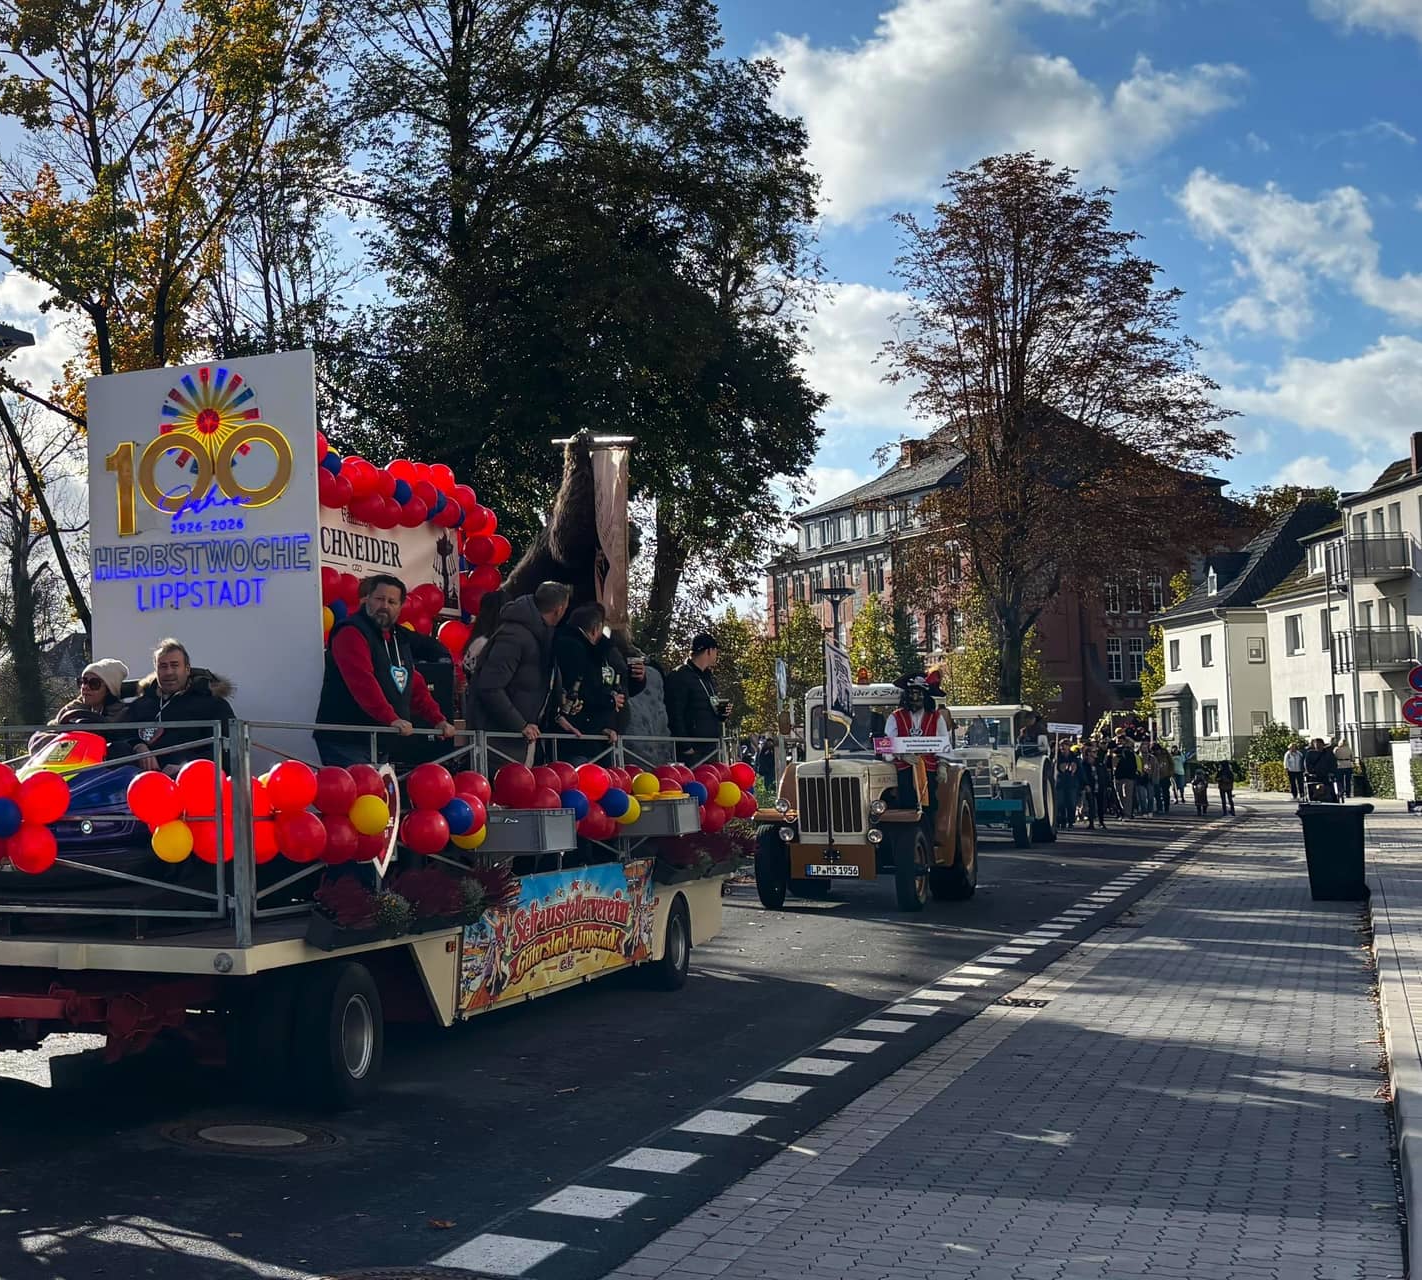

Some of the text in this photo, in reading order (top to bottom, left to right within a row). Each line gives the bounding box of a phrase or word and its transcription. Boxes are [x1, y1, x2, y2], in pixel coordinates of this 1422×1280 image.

[105, 422, 294, 536] 100
[170, 519, 244, 535] 1926-2026
[320, 526, 403, 569] CHNEIDER
[94, 532, 312, 581] HERBSTWOCHE
[136, 577, 266, 612] LIPPSTADT
[513, 893, 630, 951] Schaustellerverein
